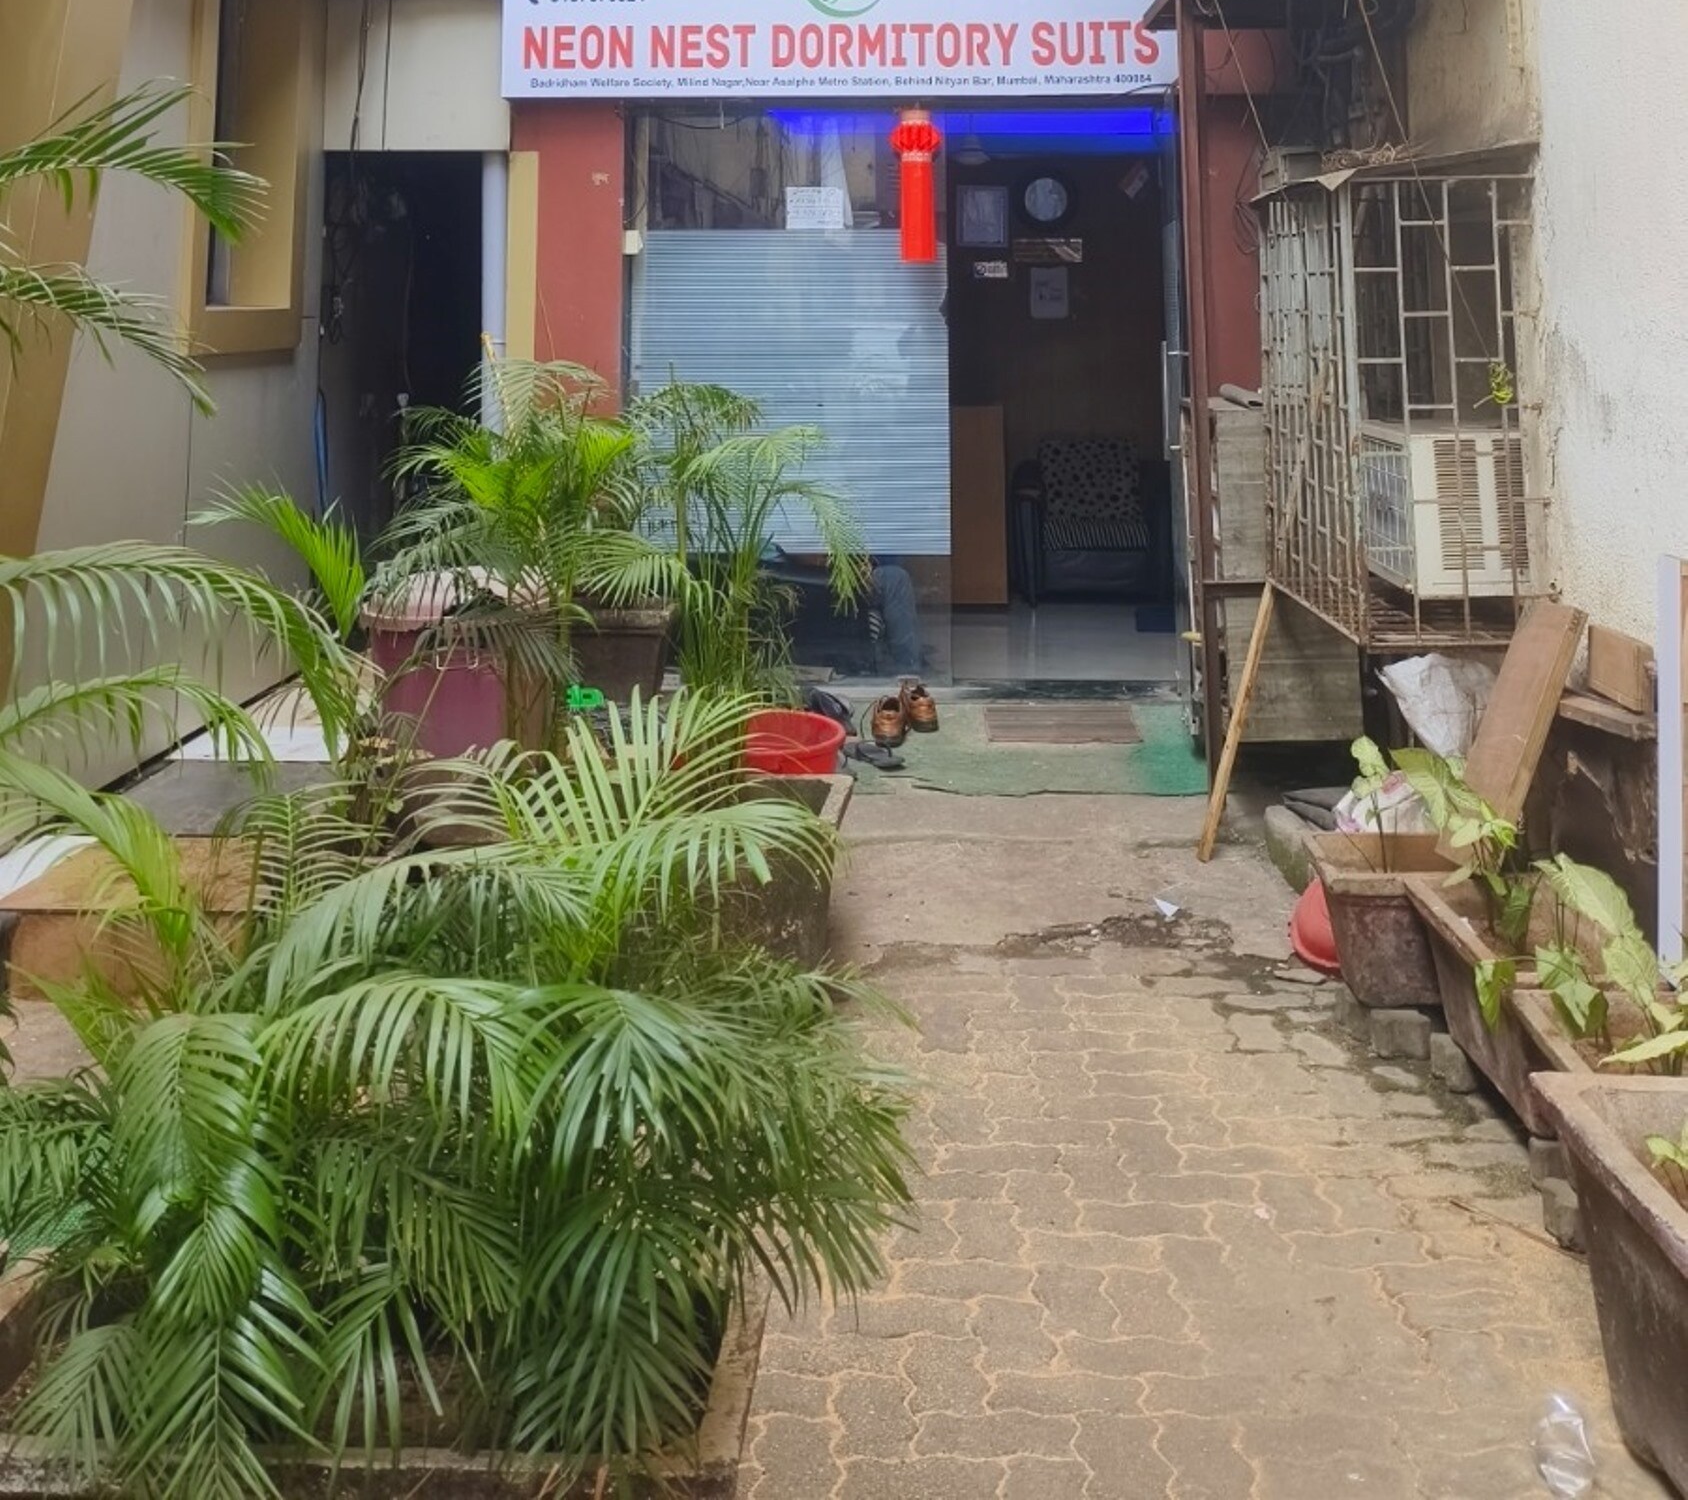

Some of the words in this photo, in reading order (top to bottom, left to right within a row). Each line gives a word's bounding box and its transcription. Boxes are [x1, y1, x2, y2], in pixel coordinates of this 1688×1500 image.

[523, 24, 634, 70] NEON
[650, 23, 756, 69] NEST
[771, 22, 1019, 69] DORMITORY
[1031, 20, 1160, 66] SUITS
[590, 77, 631, 88] Welfare
[633, 77, 673, 89] Society,
[677, 77, 709, 87] Milind
[818, 76, 848, 87] Metro
[851, 76, 891, 88] Station,
[895, 76, 932, 87] Behind
[973, 76, 994, 87] Bar,
[997, 75, 1041, 86] Mumbai,
[1044, 74, 1111, 85] Maharashtra
